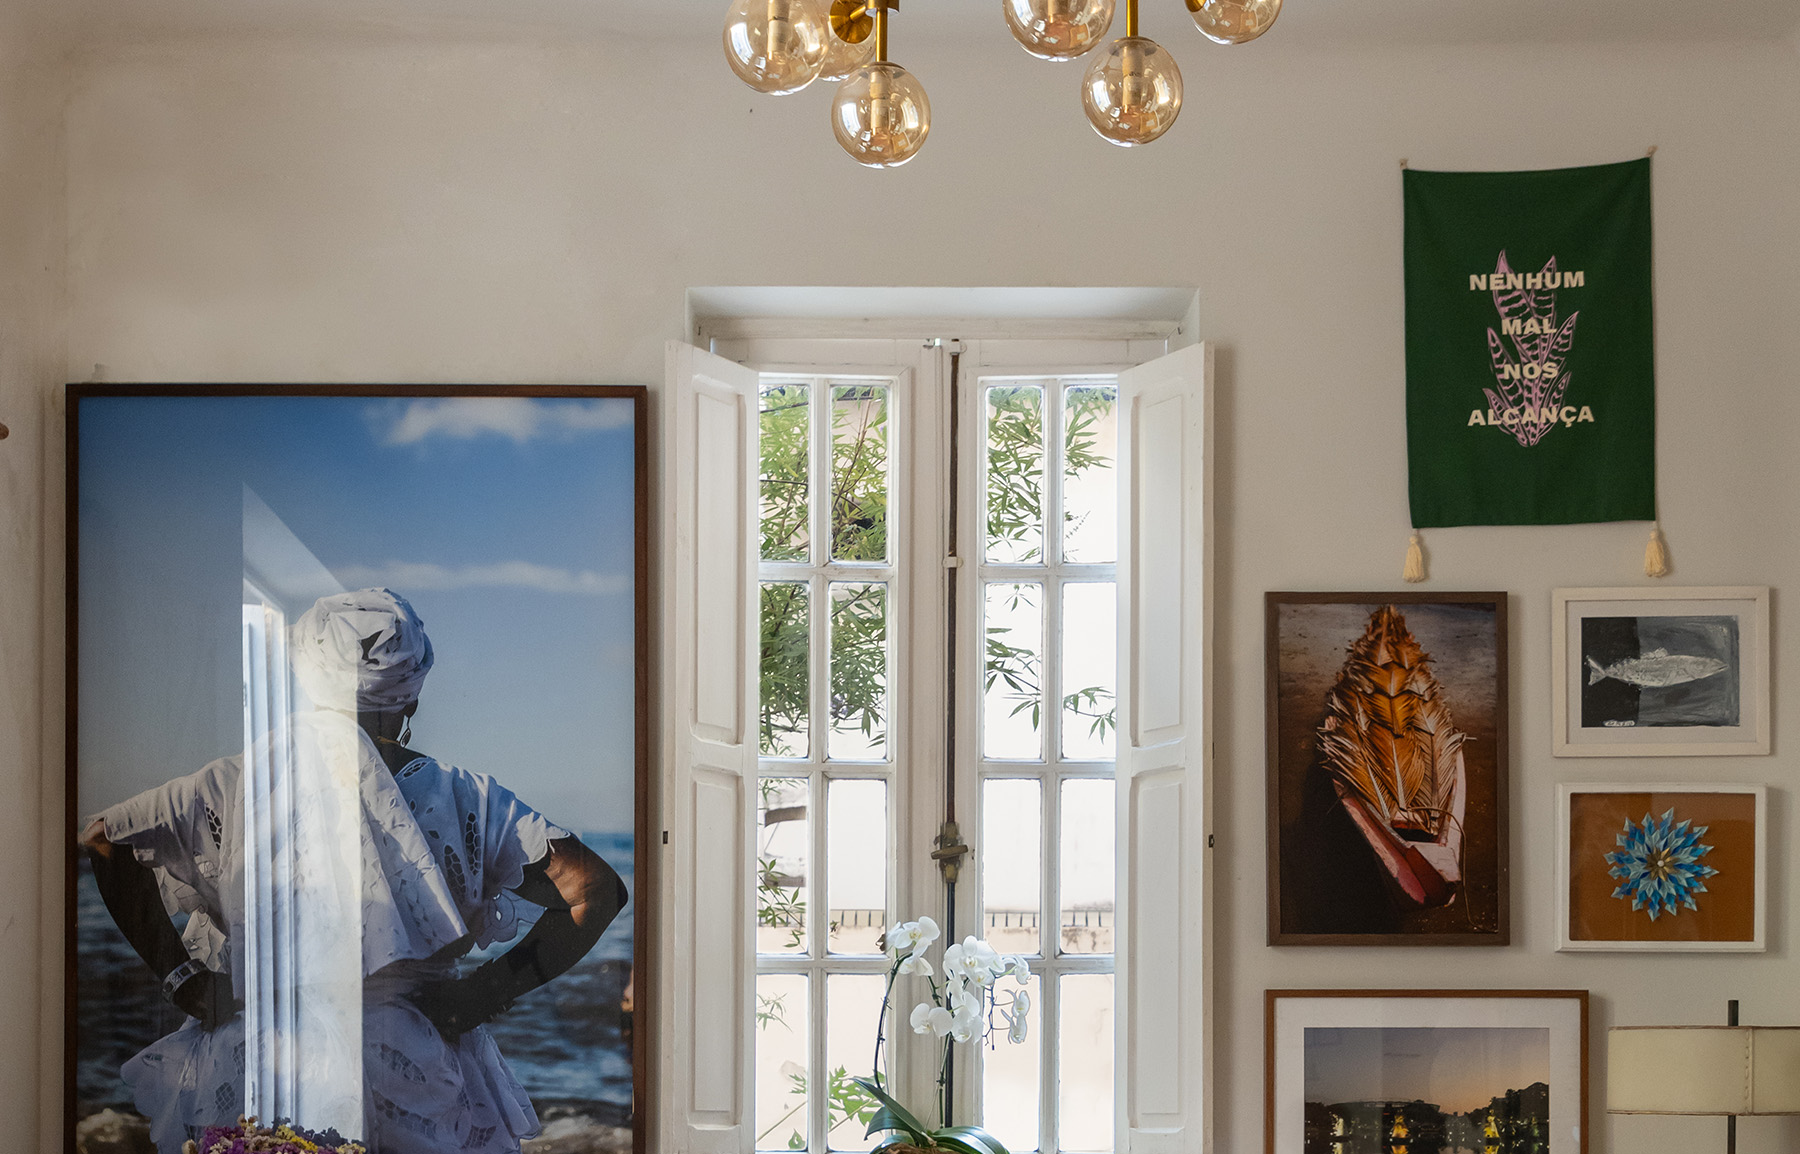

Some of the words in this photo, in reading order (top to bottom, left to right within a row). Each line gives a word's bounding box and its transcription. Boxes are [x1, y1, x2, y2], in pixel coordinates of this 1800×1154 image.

[1469, 270, 1585, 291] NENHUM
[1501, 318, 1558, 336] MAL
[1503, 361, 1559, 380] NOS
[1467, 405, 1595, 427] ALCANÇA
